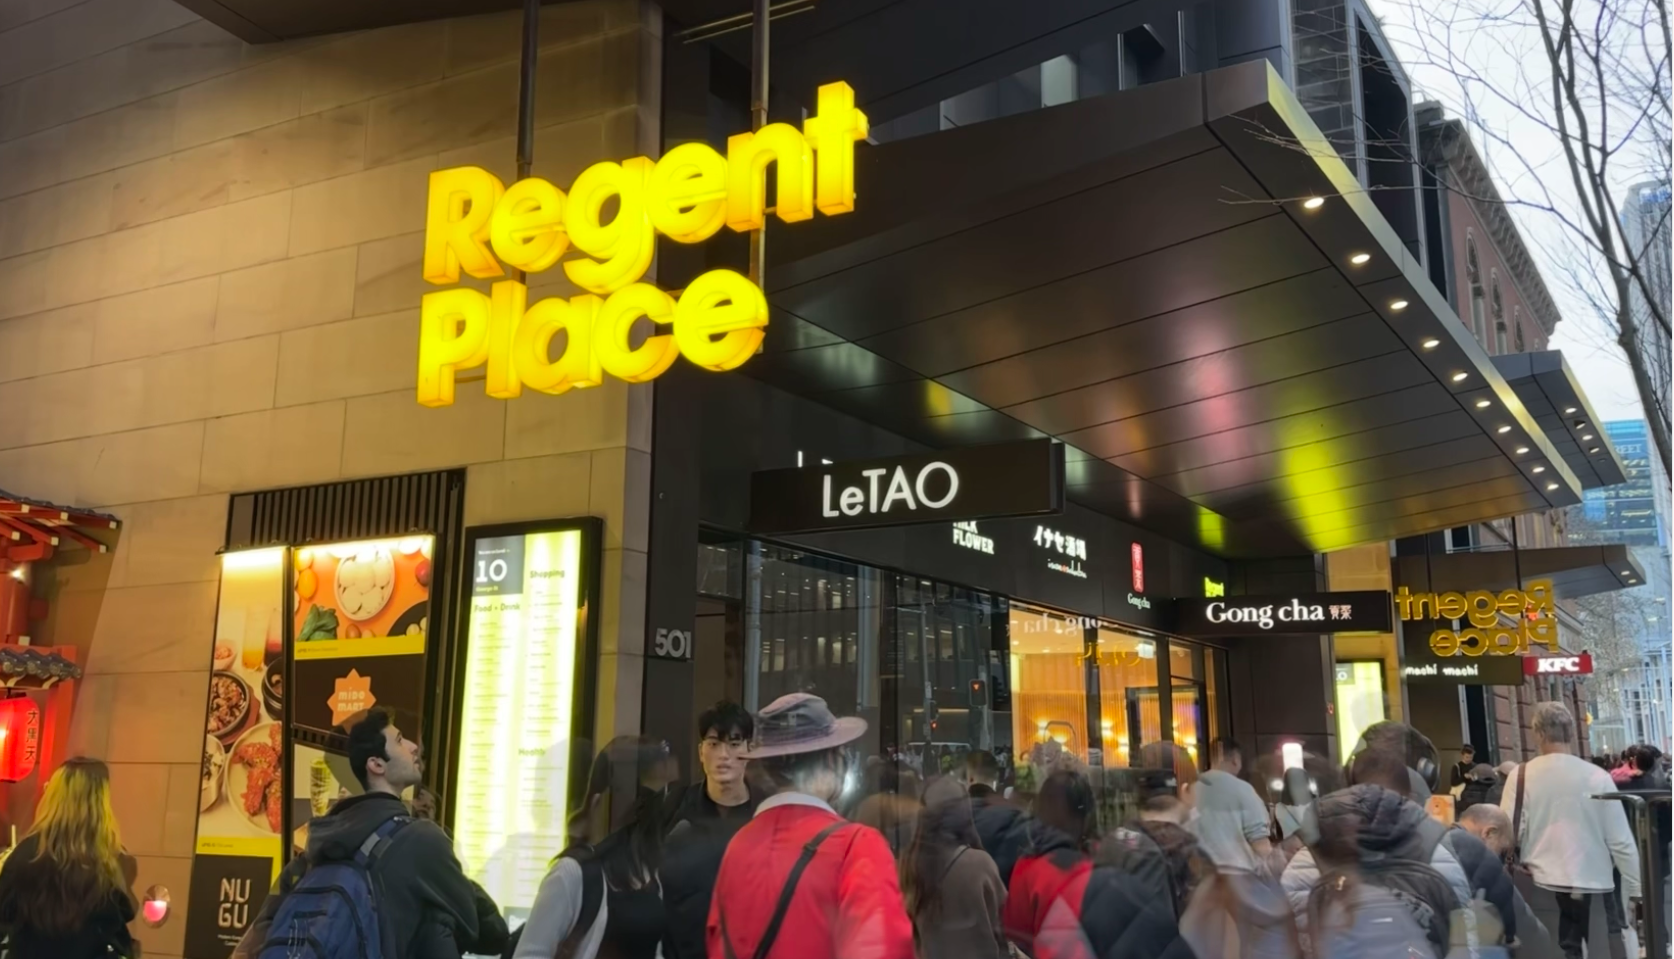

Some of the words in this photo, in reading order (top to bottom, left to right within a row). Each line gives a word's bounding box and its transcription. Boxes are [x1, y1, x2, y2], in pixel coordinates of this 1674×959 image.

[423, 80, 868, 294] Regent
[417, 268, 769, 407] Place
[823, 461, 959, 518] LeTAO
[953, 528, 995, 555] FLOWER
[476, 559, 508, 583] 10
[530, 570, 565, 579] Shopping
[474, 604, 493, 612] Food
[500, 602, 521, 611] Drink
[1206, 602, 1273, 629] Gong
[1278, 599, 1325, 621] cha
[655, 628, 692, 659] 501
[1405, 664, 1437, 676] machi
[1442, 664, 1479, 676] machi
[1537, 657, 1580, 673] KFC
[220, 878, 251, 903] NU
[218, 903, 249, 929] GU
